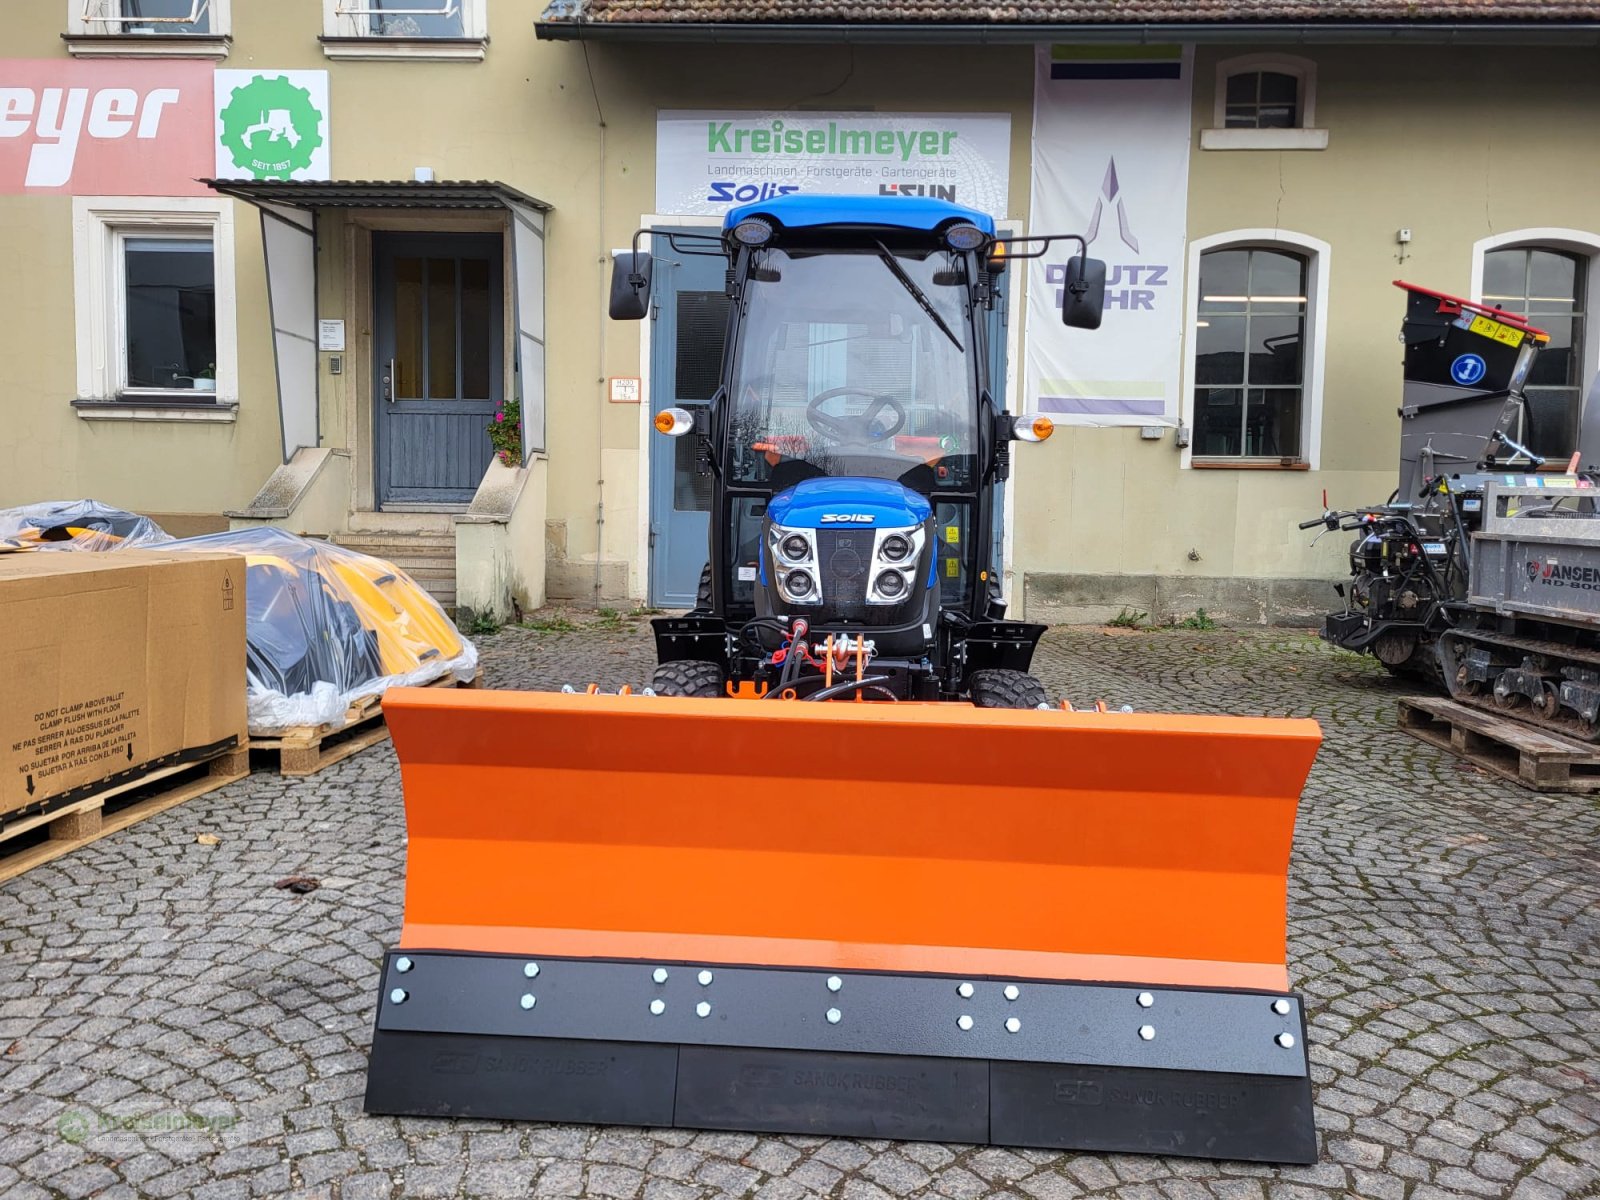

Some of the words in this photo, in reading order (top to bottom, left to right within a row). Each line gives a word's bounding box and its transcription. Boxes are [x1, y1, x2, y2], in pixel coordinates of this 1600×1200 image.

[707, 120, 958, 161] Kreiselmeyer
[251, 159, 271, 171] SEIT
[272, 159, 291, 171] 1857
[707, 164, 798, 176] Landmaschinen
[806, 165, 873, 178] Forstgeräte
[881, 166, 957, 179] Gartengeräte
[1046, 264, 1168, 286] DUTZ
[34, 712, 45, 722] DO
[45, 708, 59, 719] NOT
[60, 703, 84, 715] CLAMP
[84, 697, 105, 709] ABOVE
[106, 691, 124, 703] PALLET
[39, 718, 63, 731] CLAMP
[64, 712, 85, 724] FLUSH
[87, 708, 103, 719] WITH
[103, 703, 121, 713] FLOOR
[12, 742, 22, 752] NE
[23, 738, 36, 749] PAS
[37, 730, 64, 745] SERRER
[65, 720, 103, 737] AU-DESSUS
[103, 717, 111, 727] DE
[111, 715, 119, 723] LA
[119, 708, 140, 721] PALETTE
[35, 741, 62, 756] SERRER
[69, 735, 84, 746] RAS
[84, 732, 94, 742] DU
[95, 723, 125, 739] PLANCHER
[19, 764, 30, 774] NO
[30, 755, 59, 771] SUJETAR
[61, 750, 75, 761] POR
[76, 743, 101, 756] ARRIBA
[101, 740, 109, 749] DE
[110, 738, 118, 746] LA
[118, 731, 137, 743] PALETA
[38, 762, 67, 779] SUJETAR
[74, 756, 88, 767] RAS
[89, 753, 103, 763] CON
[103, 750, 110, 758] EL
[111, 745, 124, 755] PISO
